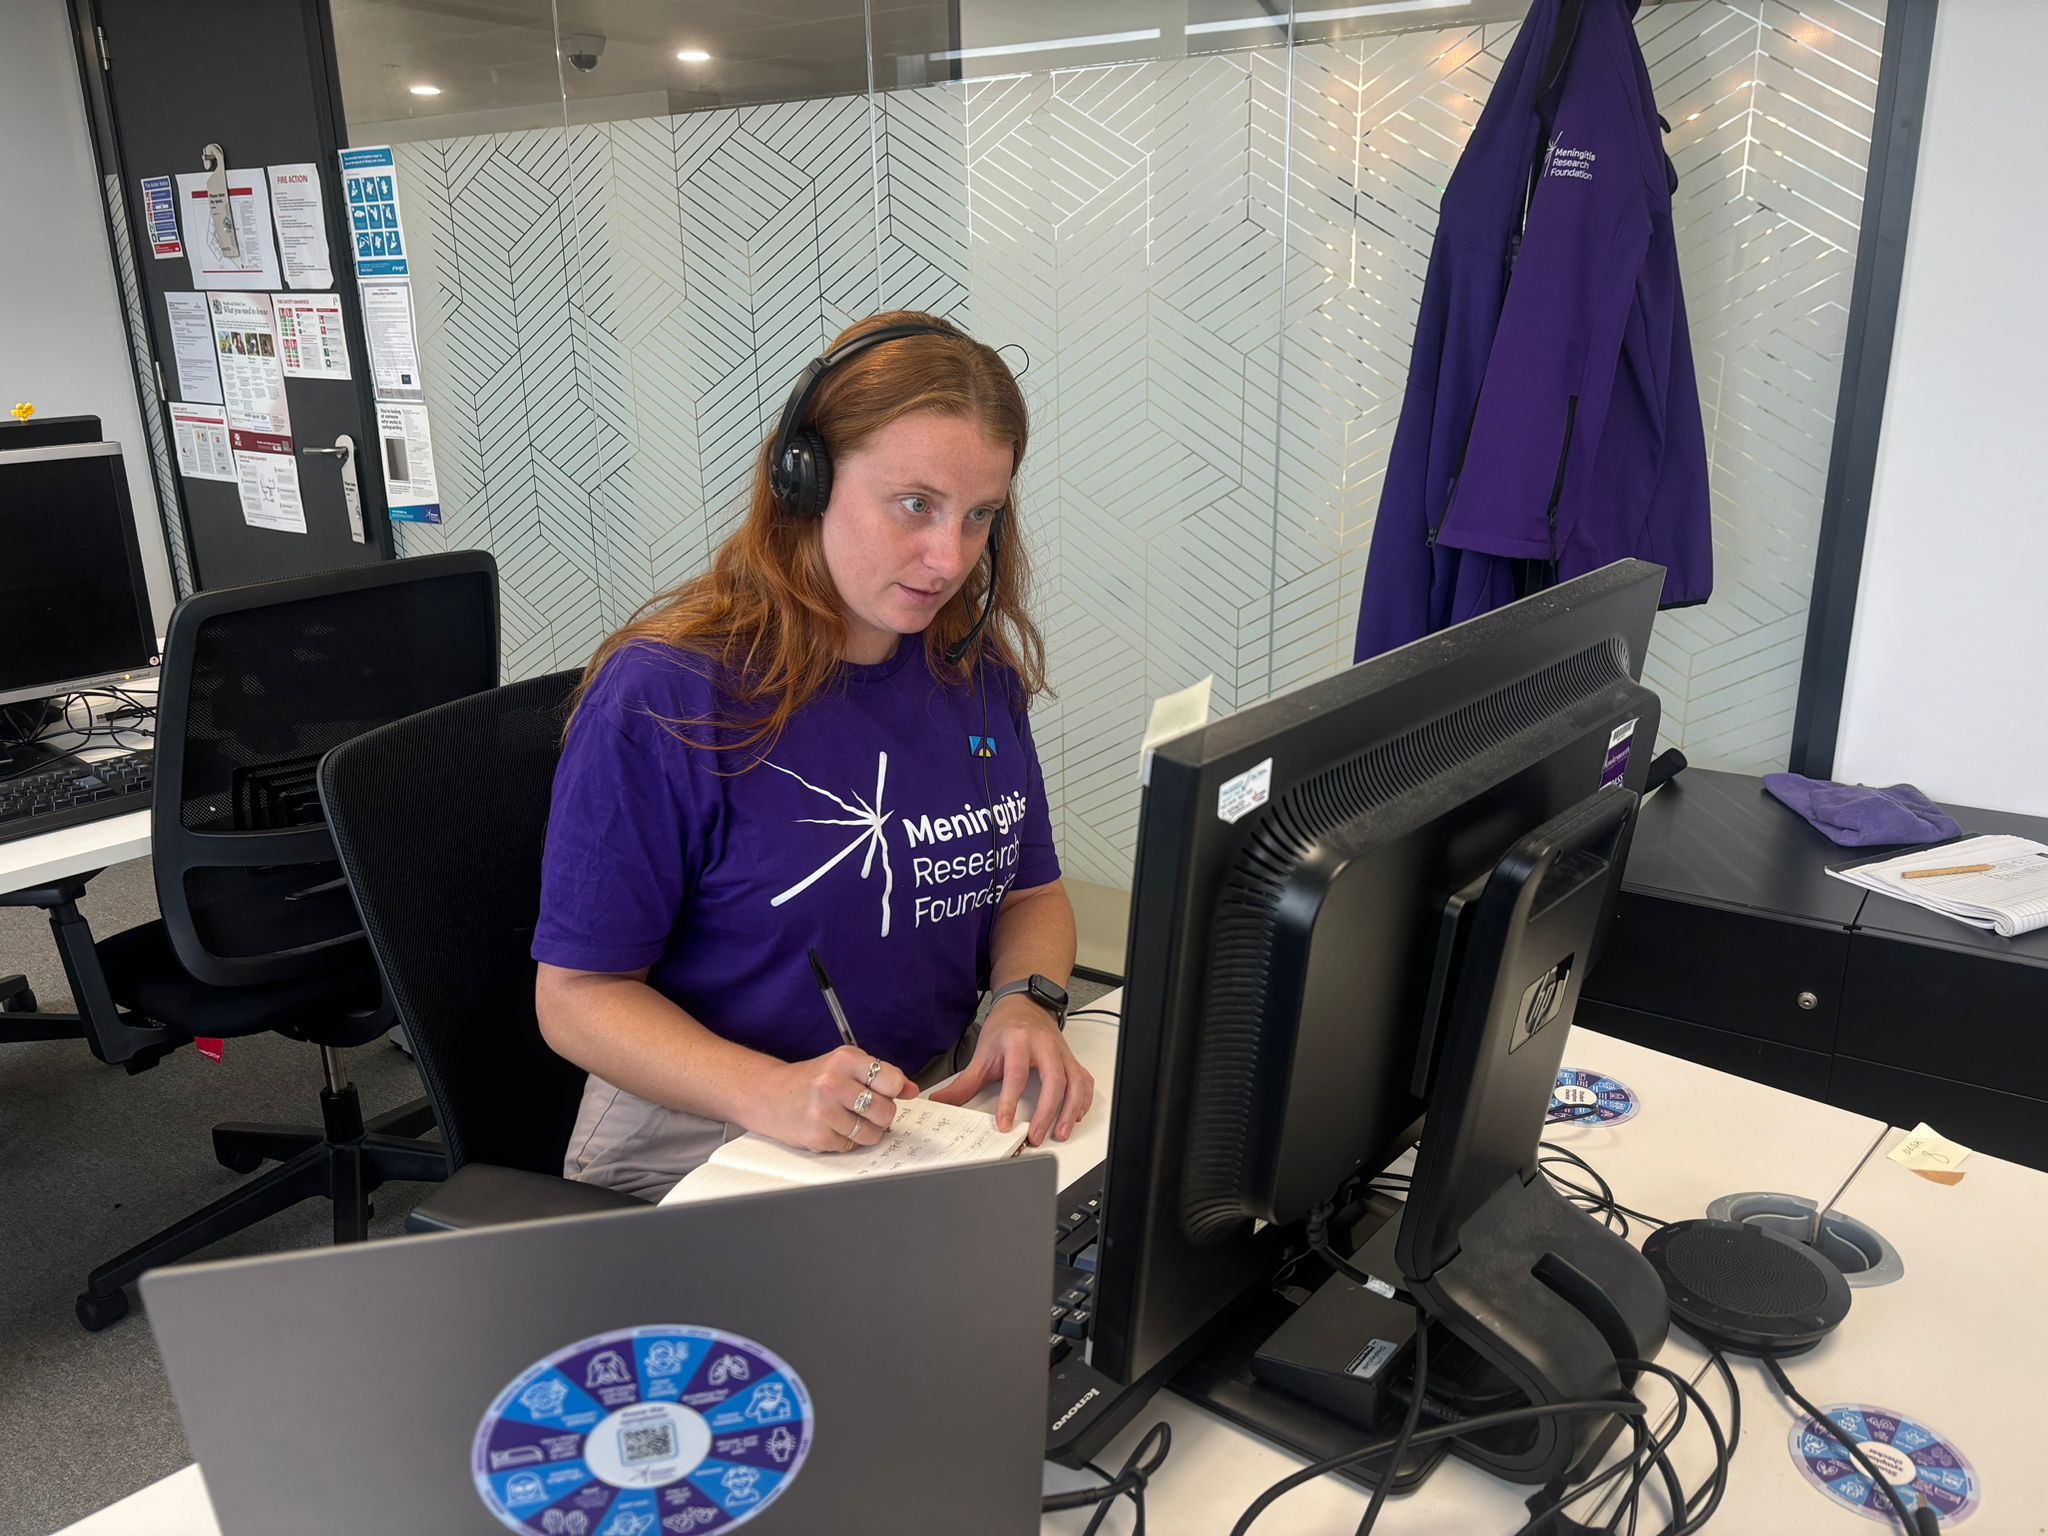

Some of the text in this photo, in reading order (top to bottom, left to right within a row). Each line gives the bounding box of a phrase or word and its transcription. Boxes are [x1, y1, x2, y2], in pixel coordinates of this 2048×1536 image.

[1555, 147, 1596, 161] Meningitis
[1552, 158, 1590, 170] Research
[276, 174, 308, 184] FIRE ACTION
[1550, 168, 1593, 181] Foundation
[902, 790, 1026, 849] Meningitis
[912, 833, 1020, 889] Research
[1052, 1388, 1100, 1431] lenovo
[1869, 1448, 1902, 1465] checker
